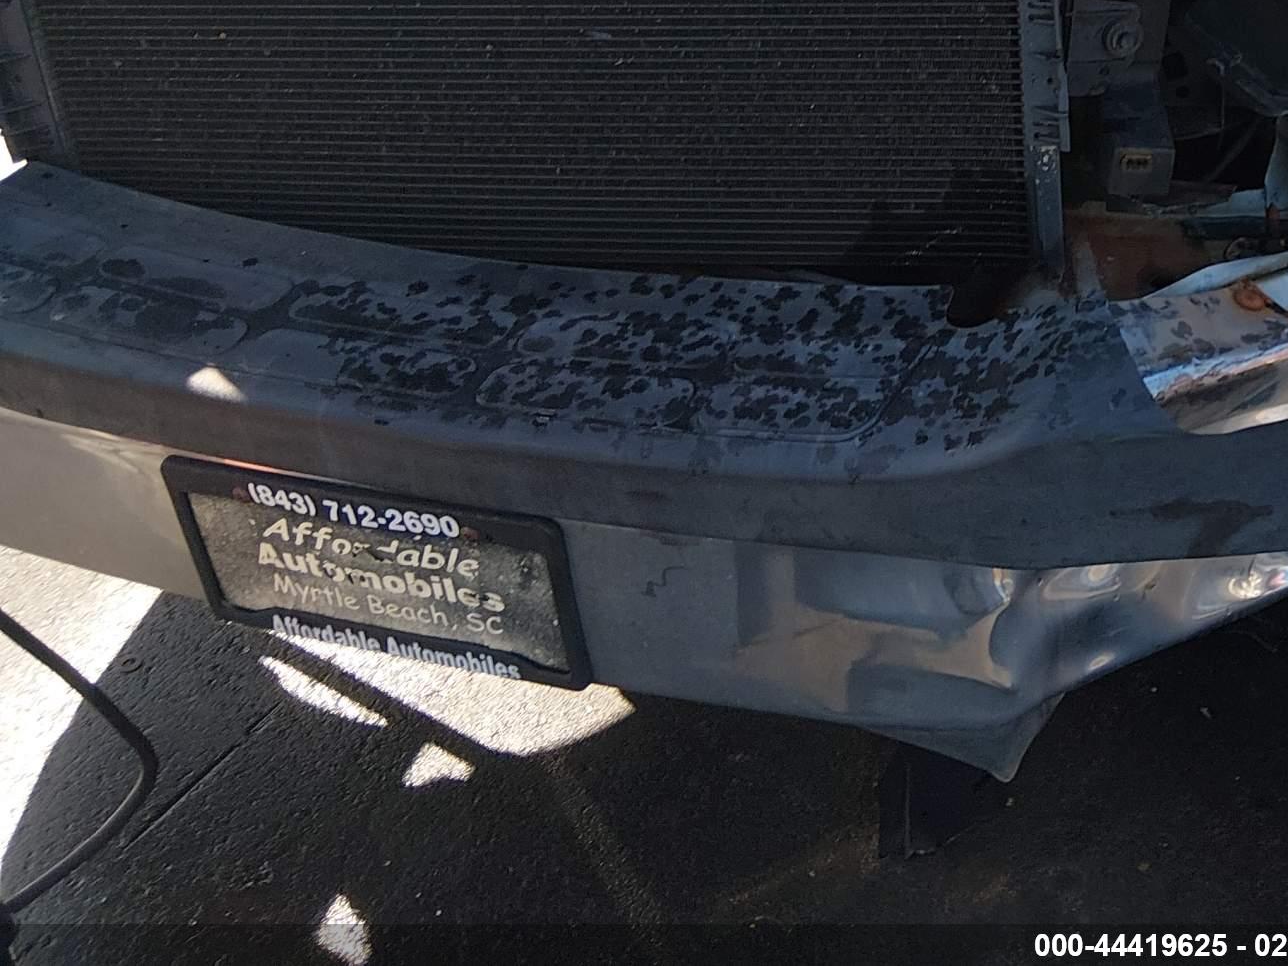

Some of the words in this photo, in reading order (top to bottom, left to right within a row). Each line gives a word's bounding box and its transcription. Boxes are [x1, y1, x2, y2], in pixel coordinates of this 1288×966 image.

[248, 483, 317, 517] (843)
[322, 499, 460, 538] 712-2690
[273, 572, 361, 611] Myrtle
[366, 593, 459, 631] Beach,
[466, 612, 504, 635] SC
[273, 614, 381, 651] Affordable
[386, 636, 522, 679] Automobiles
